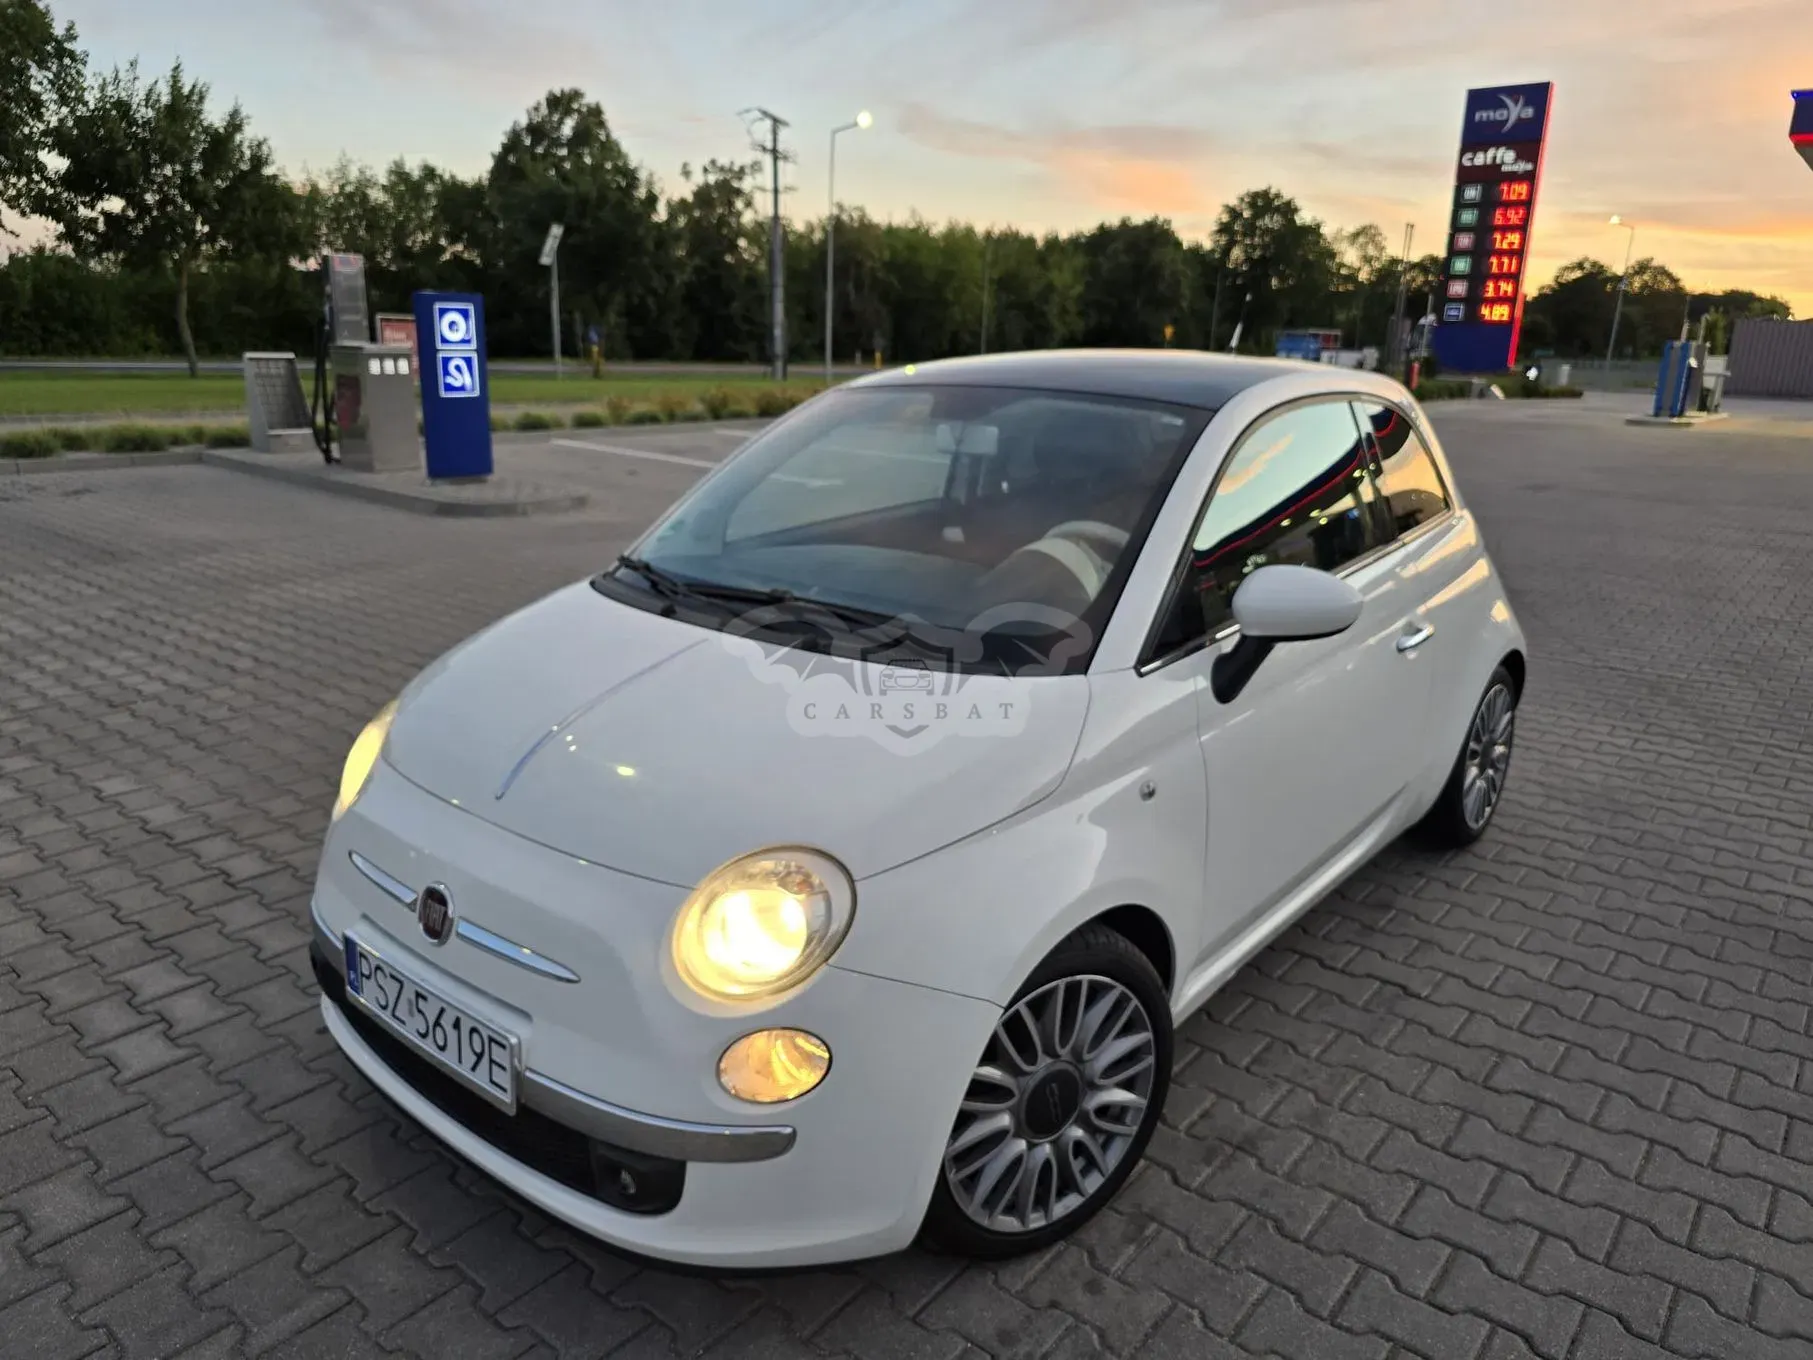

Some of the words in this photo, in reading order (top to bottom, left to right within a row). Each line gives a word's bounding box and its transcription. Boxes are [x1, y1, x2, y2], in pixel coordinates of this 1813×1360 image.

[1461, 146, 1517, 167] caffe
[358, 952, 406, 1026] PSZ
[414, 989, 508, 1093] 5619E
